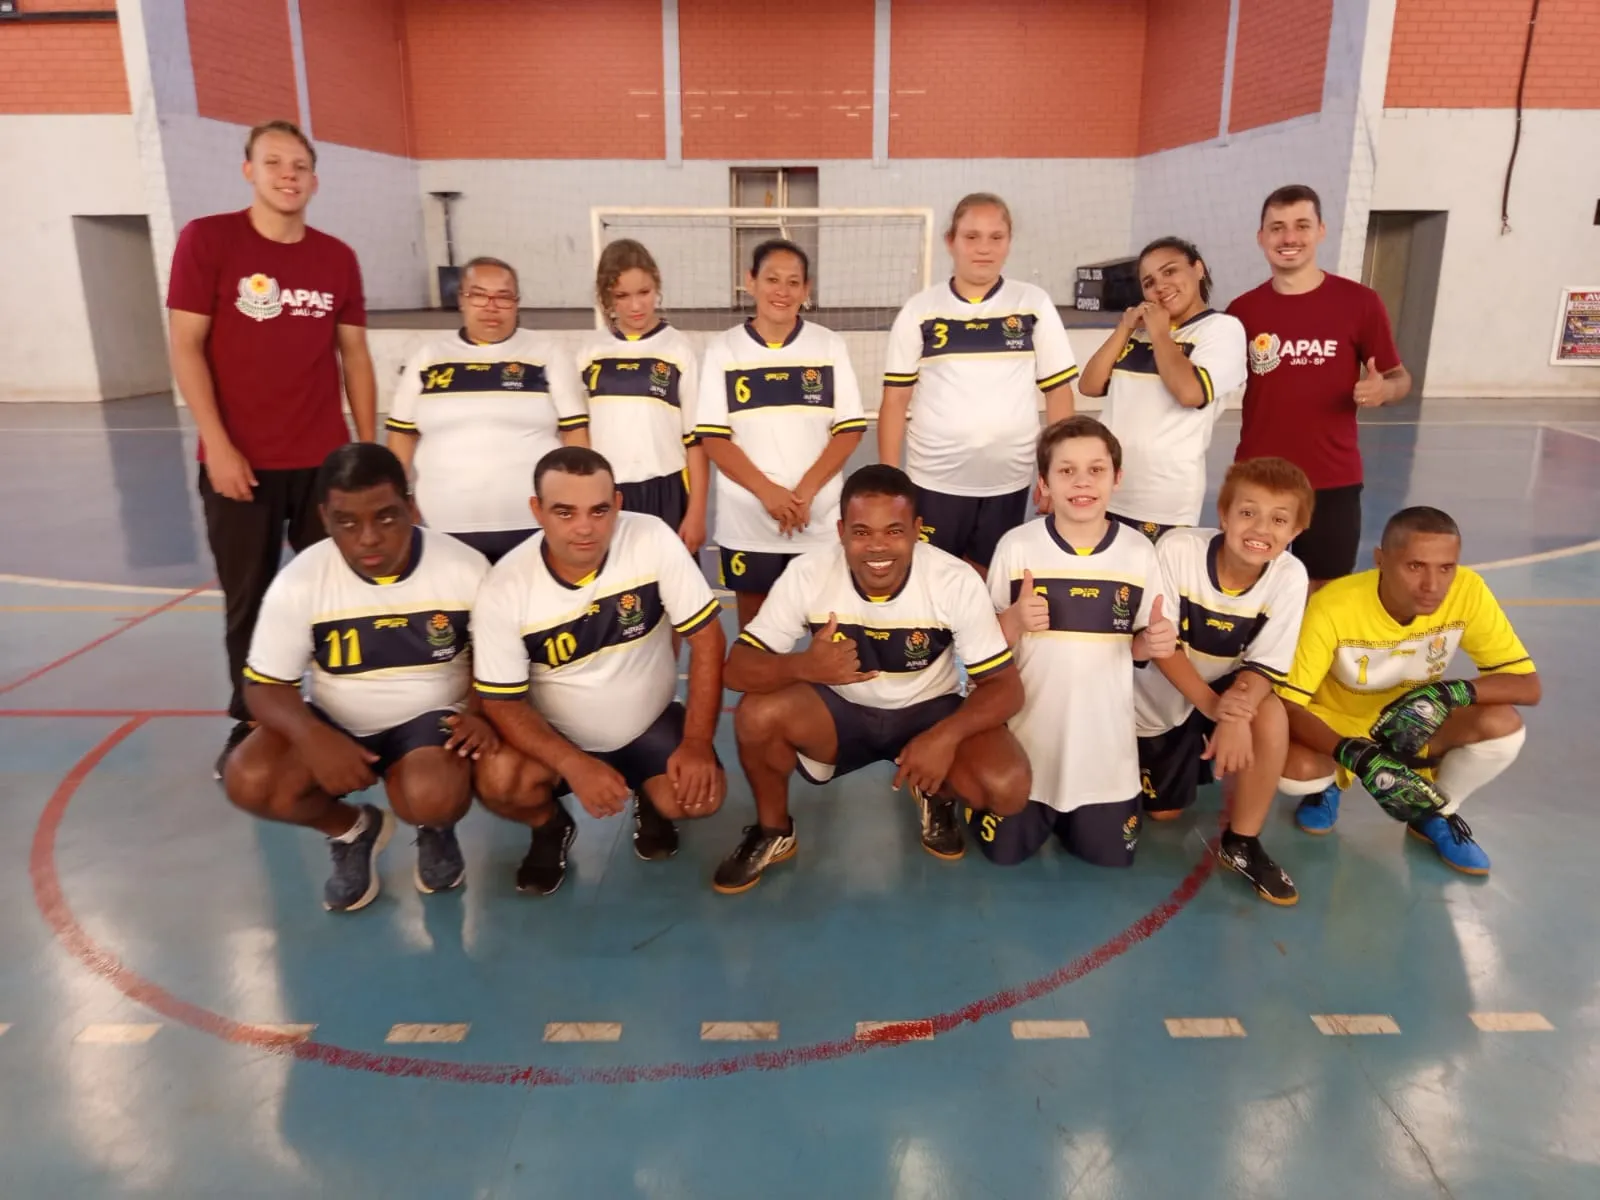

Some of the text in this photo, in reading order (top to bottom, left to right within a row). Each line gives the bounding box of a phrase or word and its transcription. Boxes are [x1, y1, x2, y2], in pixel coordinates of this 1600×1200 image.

[281, 289, 334, 311] APAE
[932, 323, 949, 348] 3
[1280, 340, 1338, 357] APAE
[1314, 358, 1326, 366] SP
[425, 367, 455, 389] 14
[589, 363, 602, 391] 7
[735, 376, 751, 403] 6
[730, 552, 746, 576] 6
[325, 628, 362, 667] 11
[544, 631, 577, 667] 10
[1355, 655, 1370, 684] 1
